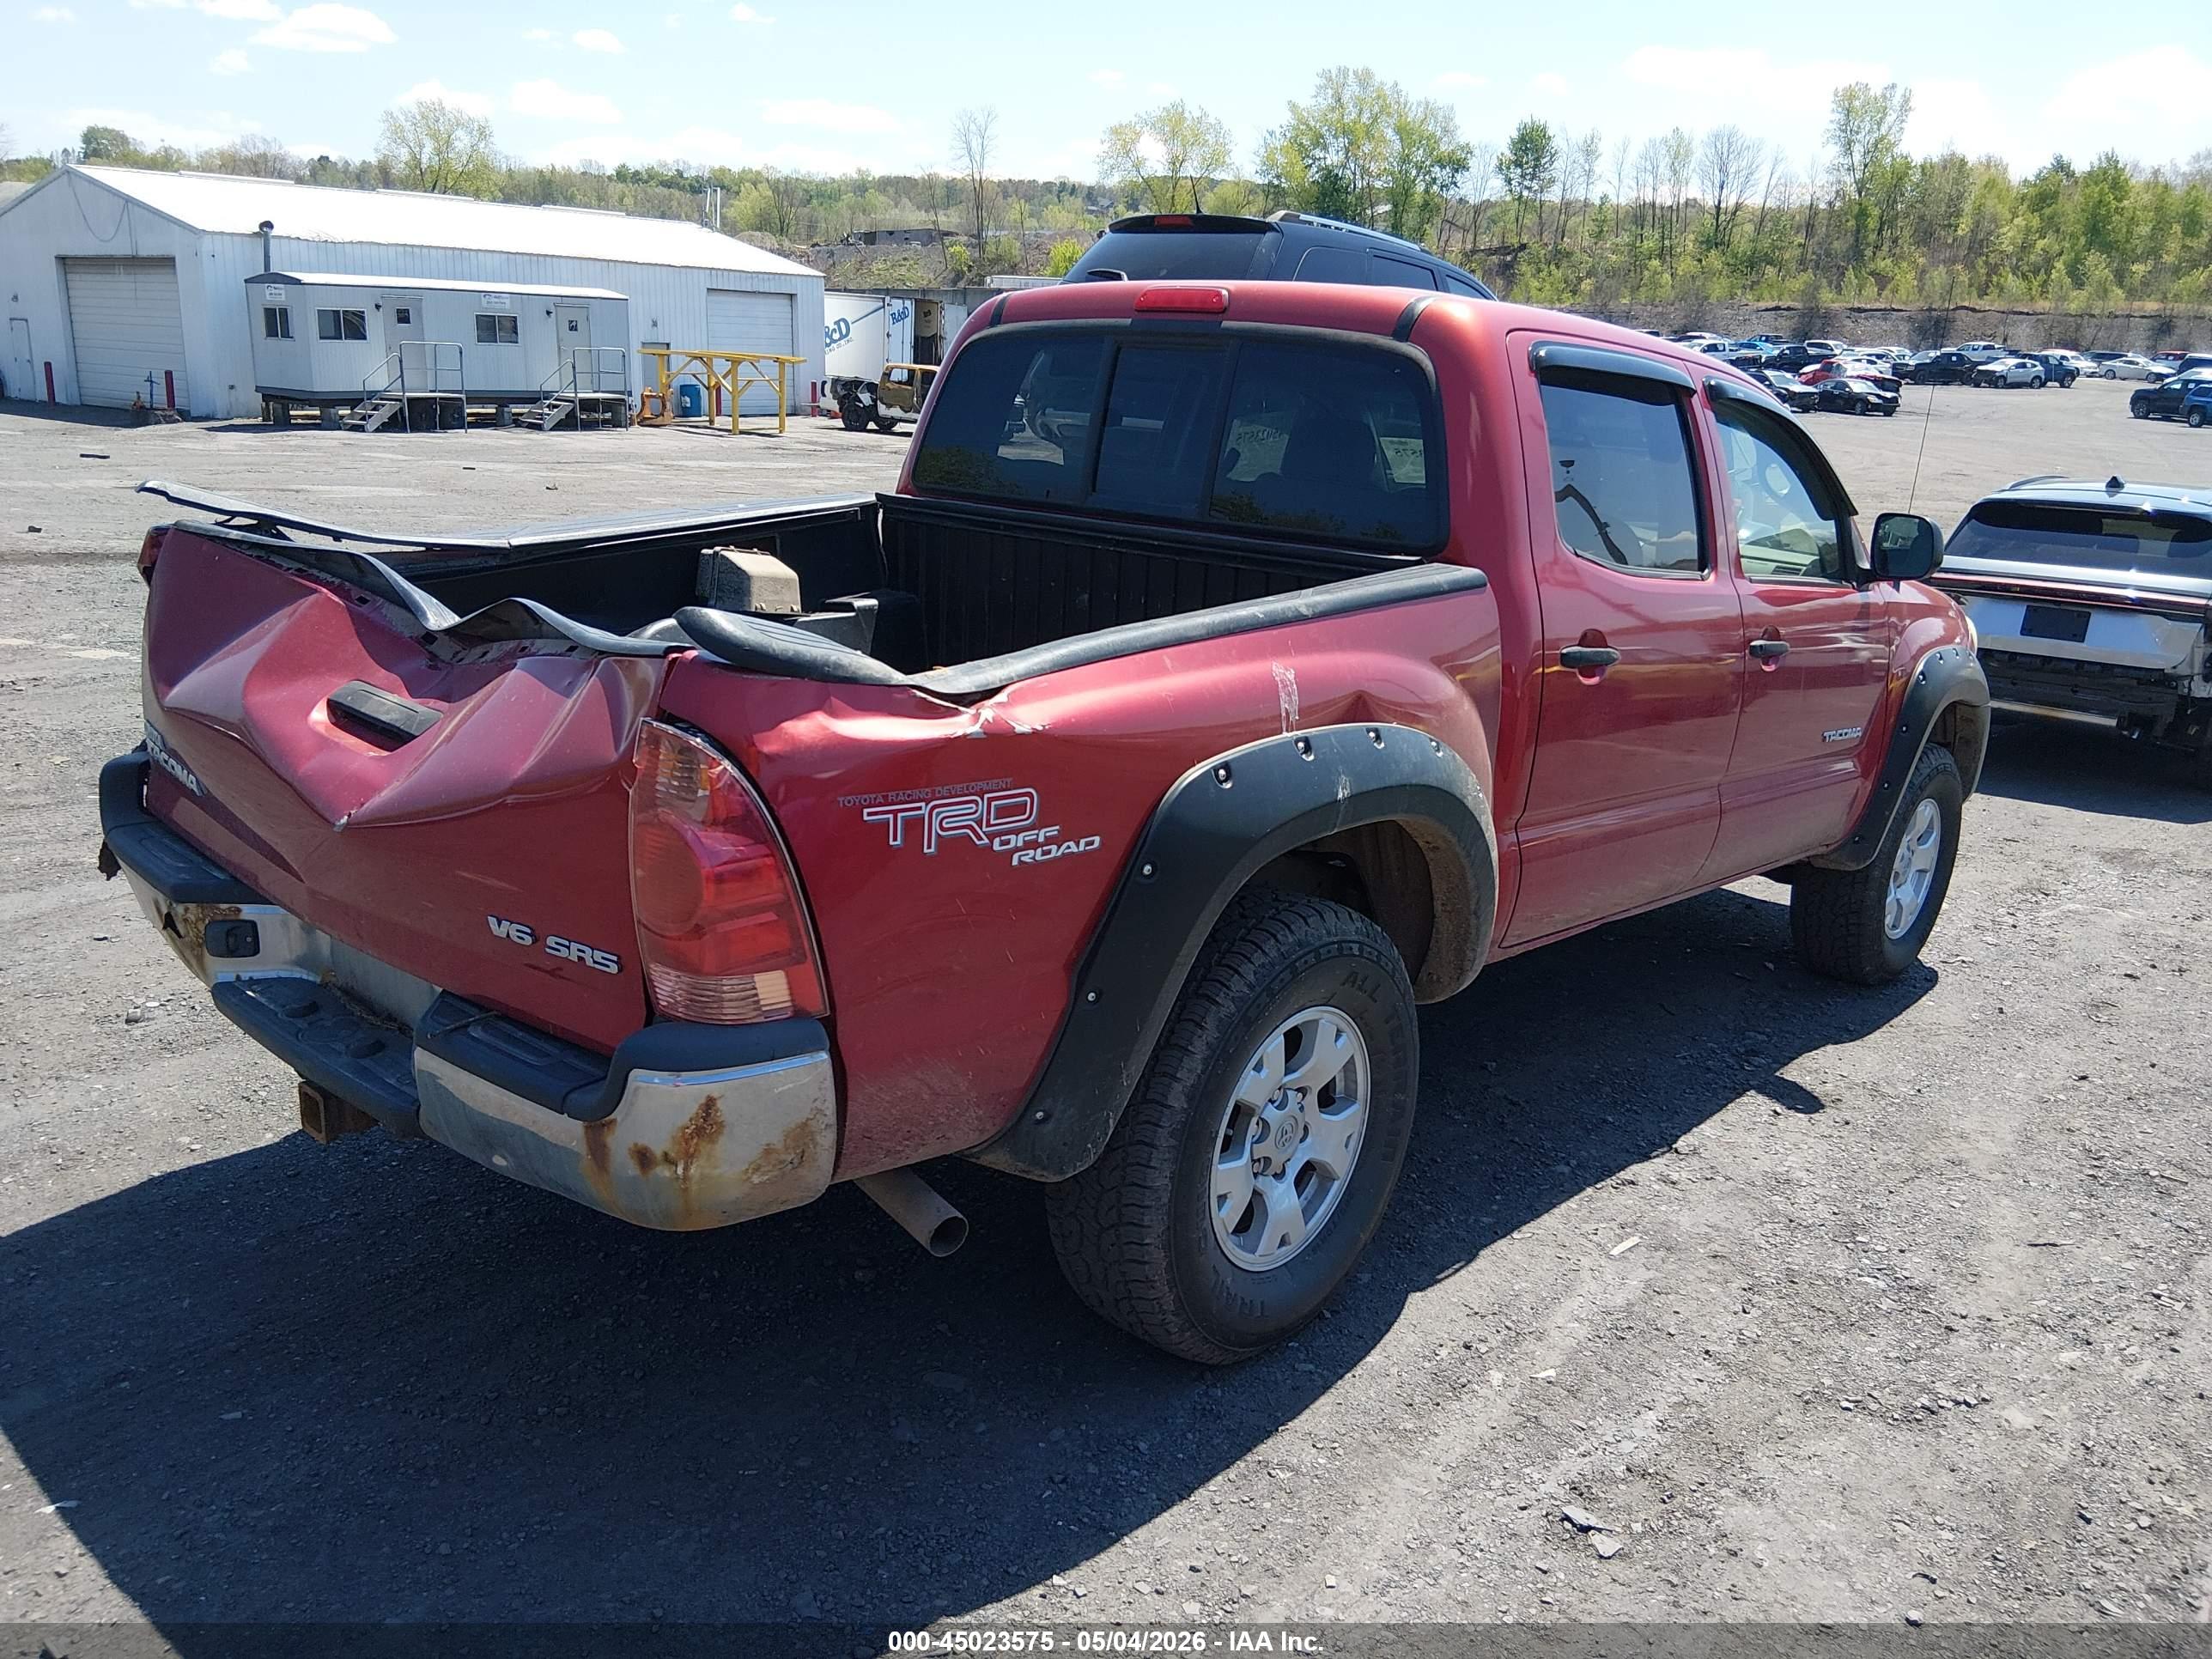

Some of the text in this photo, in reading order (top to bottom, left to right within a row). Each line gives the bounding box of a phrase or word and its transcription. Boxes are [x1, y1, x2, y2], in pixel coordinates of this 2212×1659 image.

[890, 306, 910, 325] R&D
[824, 317, 851, 348] &D
[1823, 726, 1863, 743] TACOMA
[837, 777, 1013, 808] TOYOTA RACING DEVELOPMENT
[863, 787, 1039, 855] TRD
[992, 824, 1060, 853] OFF
[1011, 835, 1101, 867] ROAD
[487, 915, 622, 975] V6 SR5
[1340, 969, 1384, 1004] ALL
